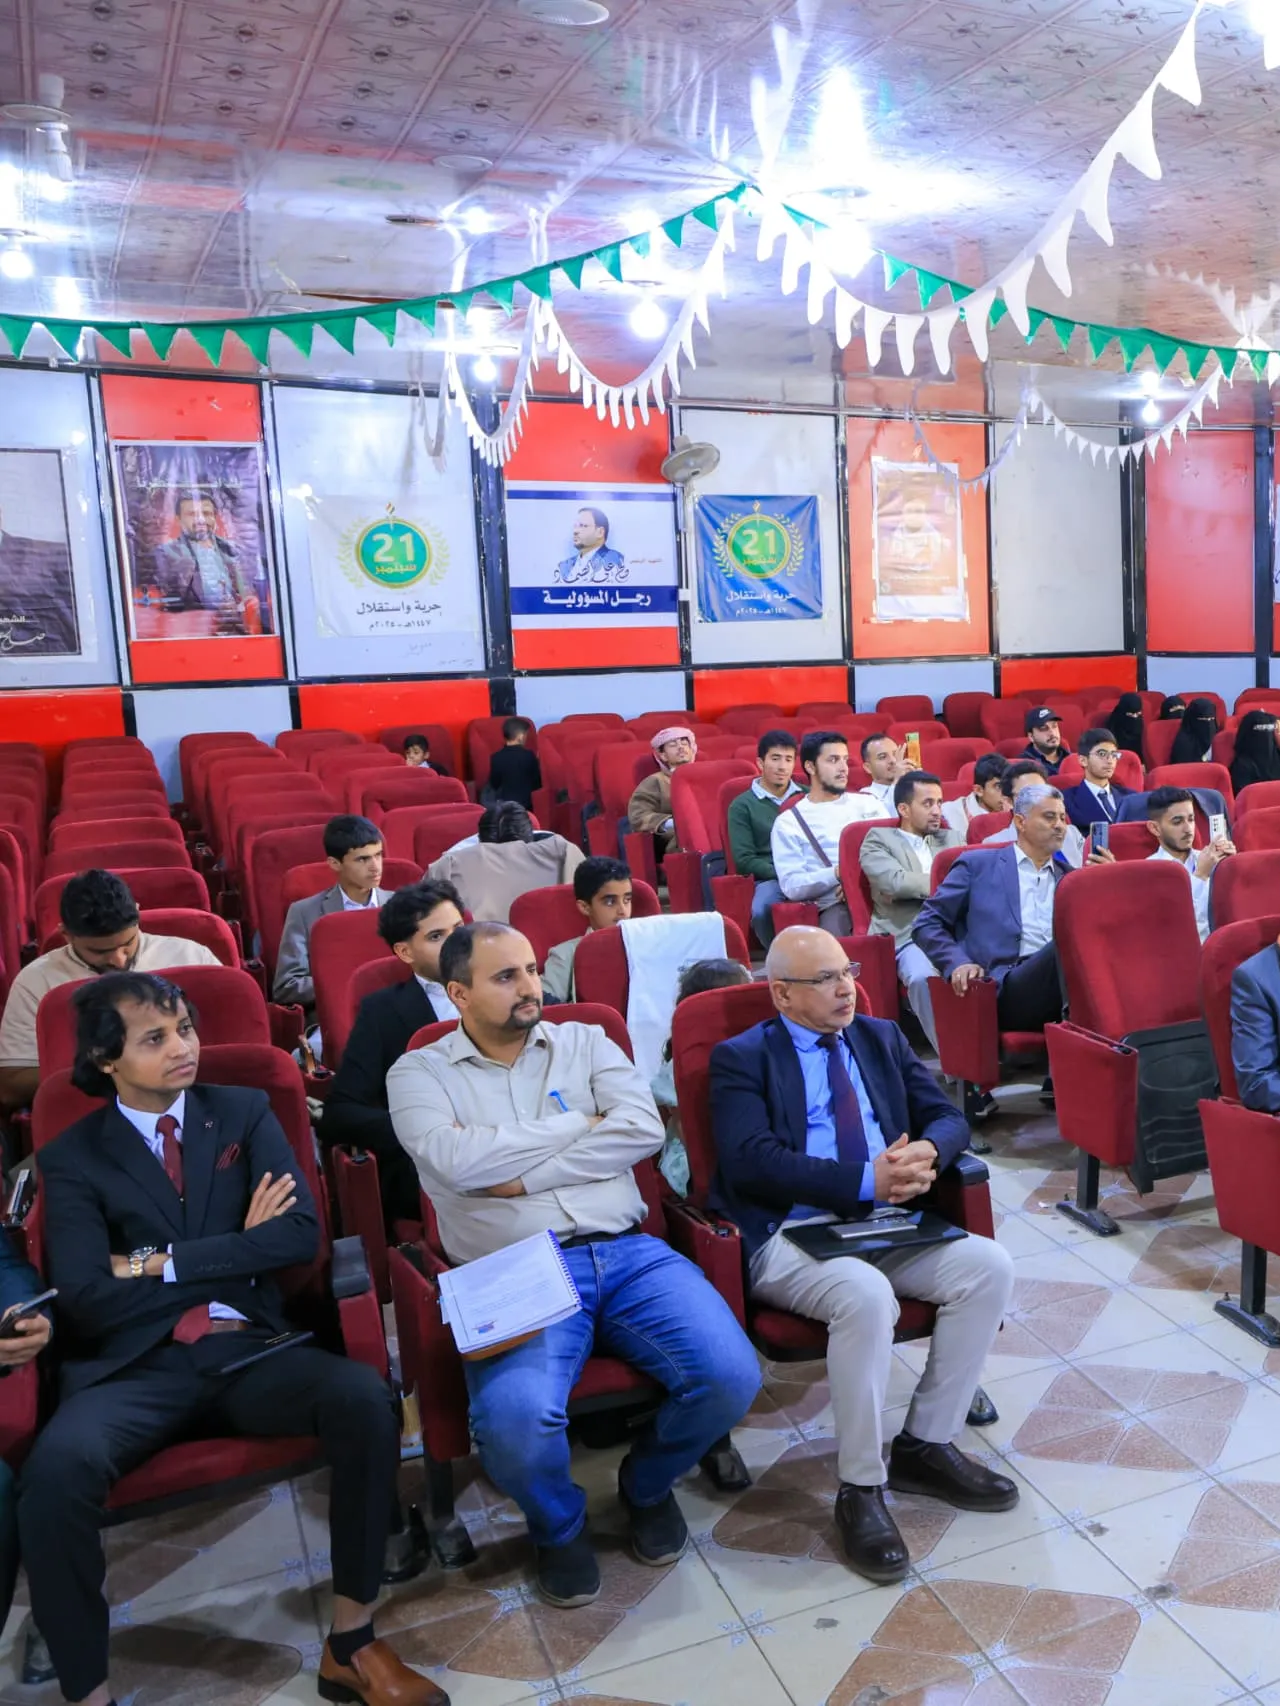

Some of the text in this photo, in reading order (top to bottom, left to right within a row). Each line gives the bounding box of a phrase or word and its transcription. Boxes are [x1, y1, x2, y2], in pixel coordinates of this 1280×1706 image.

[372, 532, 415, 563] 21
[742, 529, 777, 555] 21
[542, 590, 652, 608] رجل المسؤولية
[725, 589, 771, 602] واستقلال
[356, 600, 441, 615] حرية واستقلال
